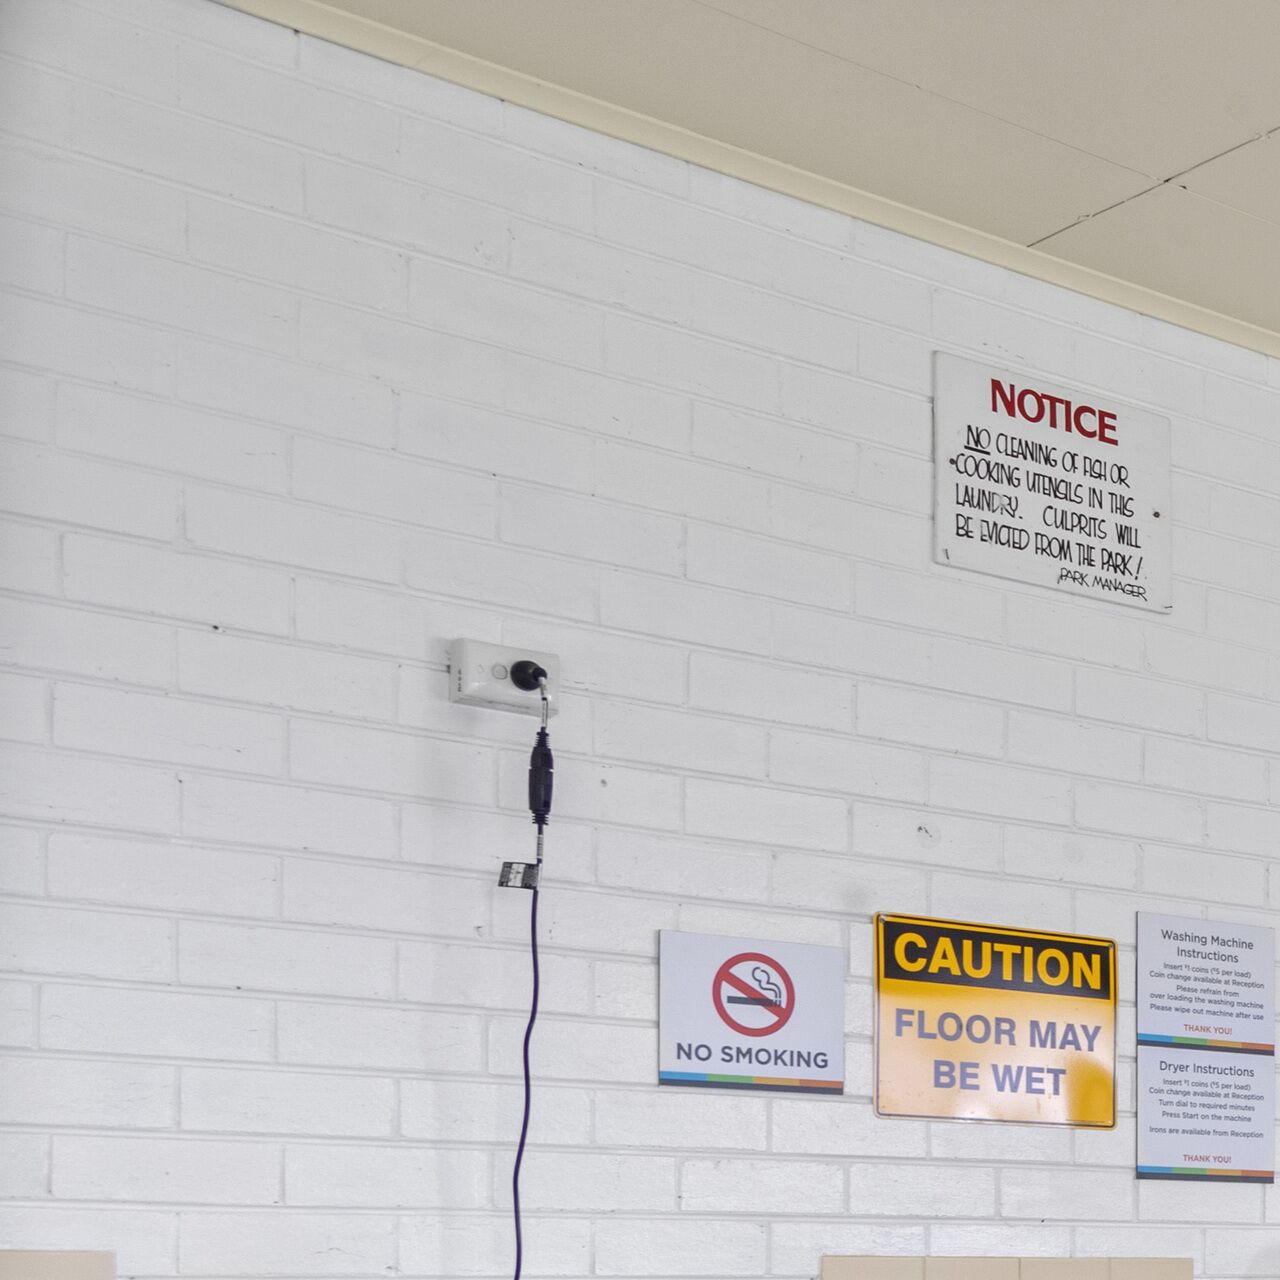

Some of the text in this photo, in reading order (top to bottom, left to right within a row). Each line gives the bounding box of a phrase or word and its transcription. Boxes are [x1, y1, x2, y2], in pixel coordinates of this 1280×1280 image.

[990, 377, 1119, 447] NOTICE
[965, 424, 1131, 489] NO CLEANING OF FISH OR
[955, 452, 1135, 518] COOKING UTENSILS IN THIS
[1042, 505, 1108, 540] CULPRITS
[1114, 522, 1142, 549] WILL
[955, 513, 975, 539] BE
[980, 519, 1031, 551] EVICTED
[1034, 532, 1073, 563] FROM
[1075, 542, 1097, 568] THE
[1057, 567, 1148, 602] PARK MANAGER
[1160, 928, 1254, 950] Washing Machine
[893, 931, 1101, 991] CAUTION
[1176, 946, 1239, 963] Instructions
[1163, 963, 1183, 971] Insert
[1191, 965, 1209, 974] coins
[1221, 969, 1233, 978] per
[1149, 970, 1265, 990] Coin change available at Reception
[1176, 984, 1240, 998] Please refrain from
[1150, 993, 1264, 1010] over loading the washing machine
[1149, 1003, 1264, 1021] Please wipe out machine after use
[894, 1008, 1103, 1053] FLOOR MAY
[1183, 1023, 1212, 1034] THANK
[675, 1042, 829, 1070] NO SMOKING
[933, 1059, 1067, 1096] BE WET
[1159, 1060, 1255, 1078] Dryer Instructions
[1148, 1086, 1165, 1095] Coin
[1166, 1088, 1191, 1098] change
[1192, 1089, 1222, 1099] available
[1231, 1092, 1265, 1102] Reception
[1163, 1078, 1183, 1086] Insert
[1191, 1079, 1209, 1088] coins
[1221, 1083, 1233, 1092] per
[1158, 1099, 1175, 1107] Turn
[1175, 1099, 1188, 1108] dial
[1199, 1102, 1228, 1112] required
[1229, 1103, 1256, 1112] minutes
[1161, 1111, 1181, 1119] Press
[1182, 1111, 1199, 1120] Start
[1211, 1113, 1222, 1121] the
[1223, 1114, 1252, 1123] machine
[1149, 1126, 1167, 1134] Irons
[1181, 1127, 1211, 1136] available
[1212, 1129, 1229, 1137] from
[1230, 1130, 1264, 1140] Reception
[1183, 1154, 1211, 1163] THANK
